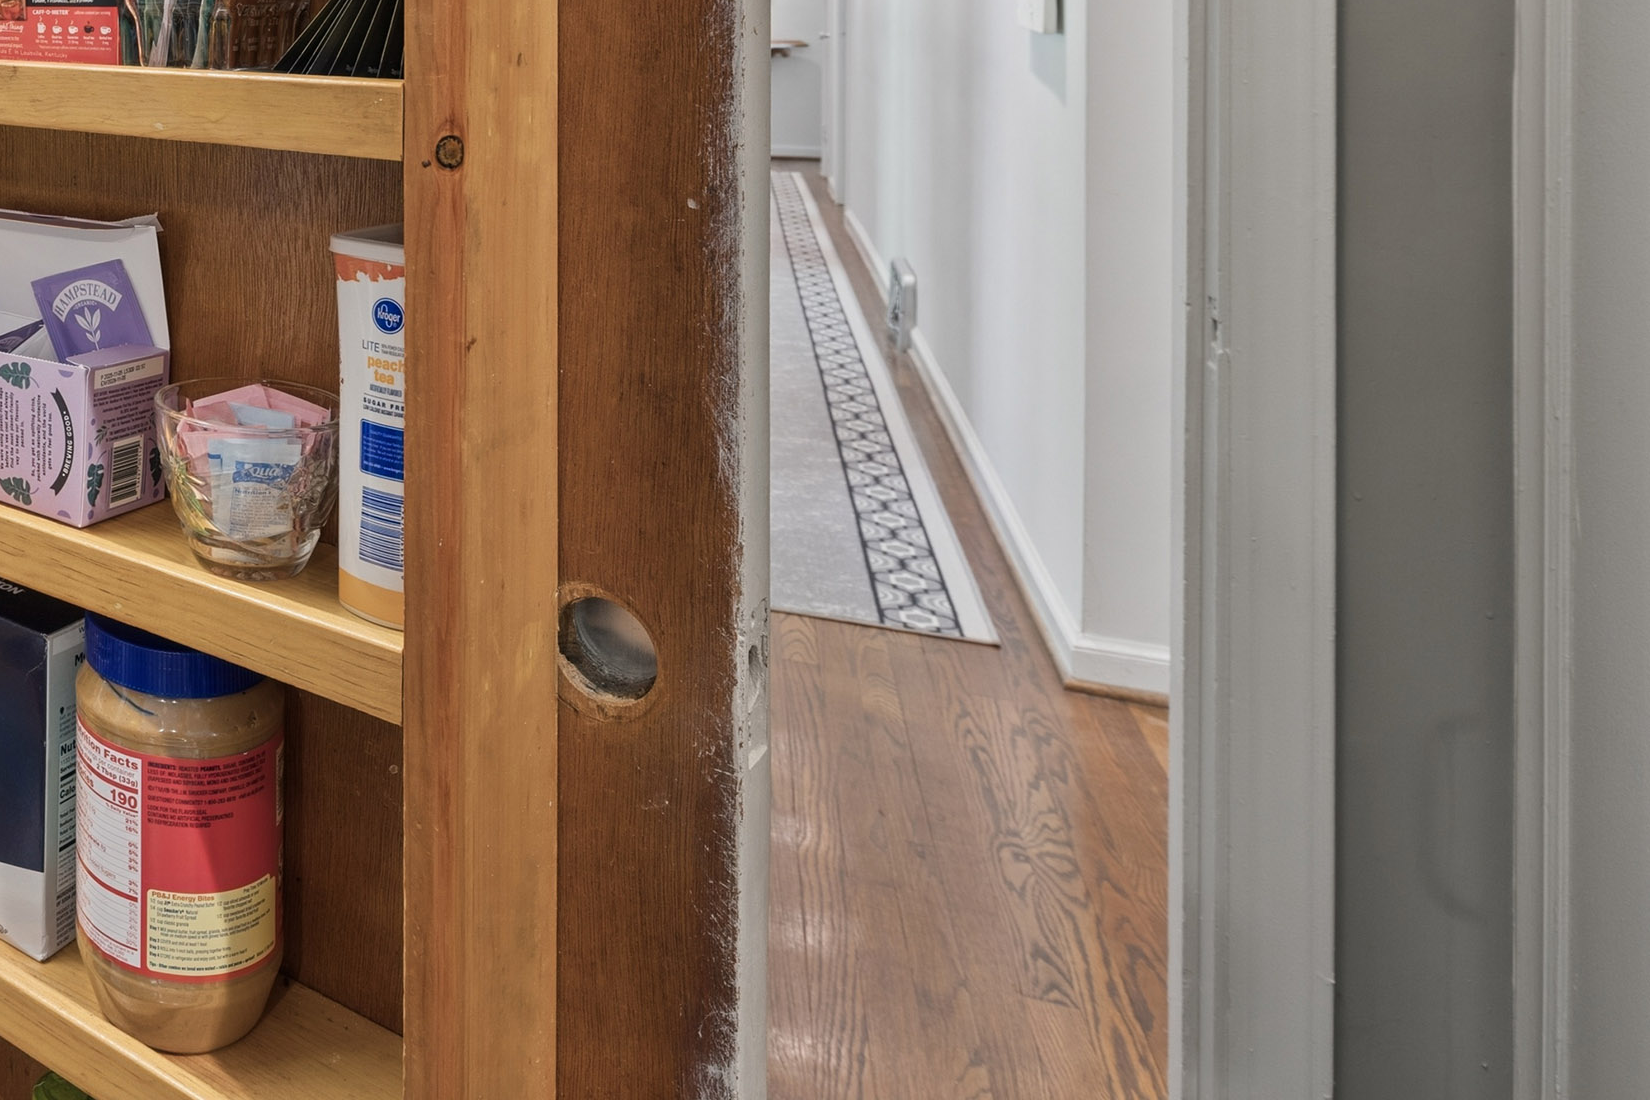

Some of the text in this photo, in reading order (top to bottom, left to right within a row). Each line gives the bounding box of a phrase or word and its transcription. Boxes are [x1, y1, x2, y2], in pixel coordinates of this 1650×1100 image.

[54, 283, 117, 318] HAMPSTEAD
[377, 303, 401, 328] Kroger
[361, 339, 380, 354] LITE
[373, 369, 395, 386] tea
[363, 396, 387, 409] SUGAR
[62, 415, 73, 474] BREWING GOOD
[103, 749, 139, 770] Facts
[101, 766, 118, 781] Tbsp
[118, 775, 139, 788] (33g)
[109, 788, 138, 810] 190
[151, 891, 170, 900] PB&J
[172, 894, 197, 903] Energy
